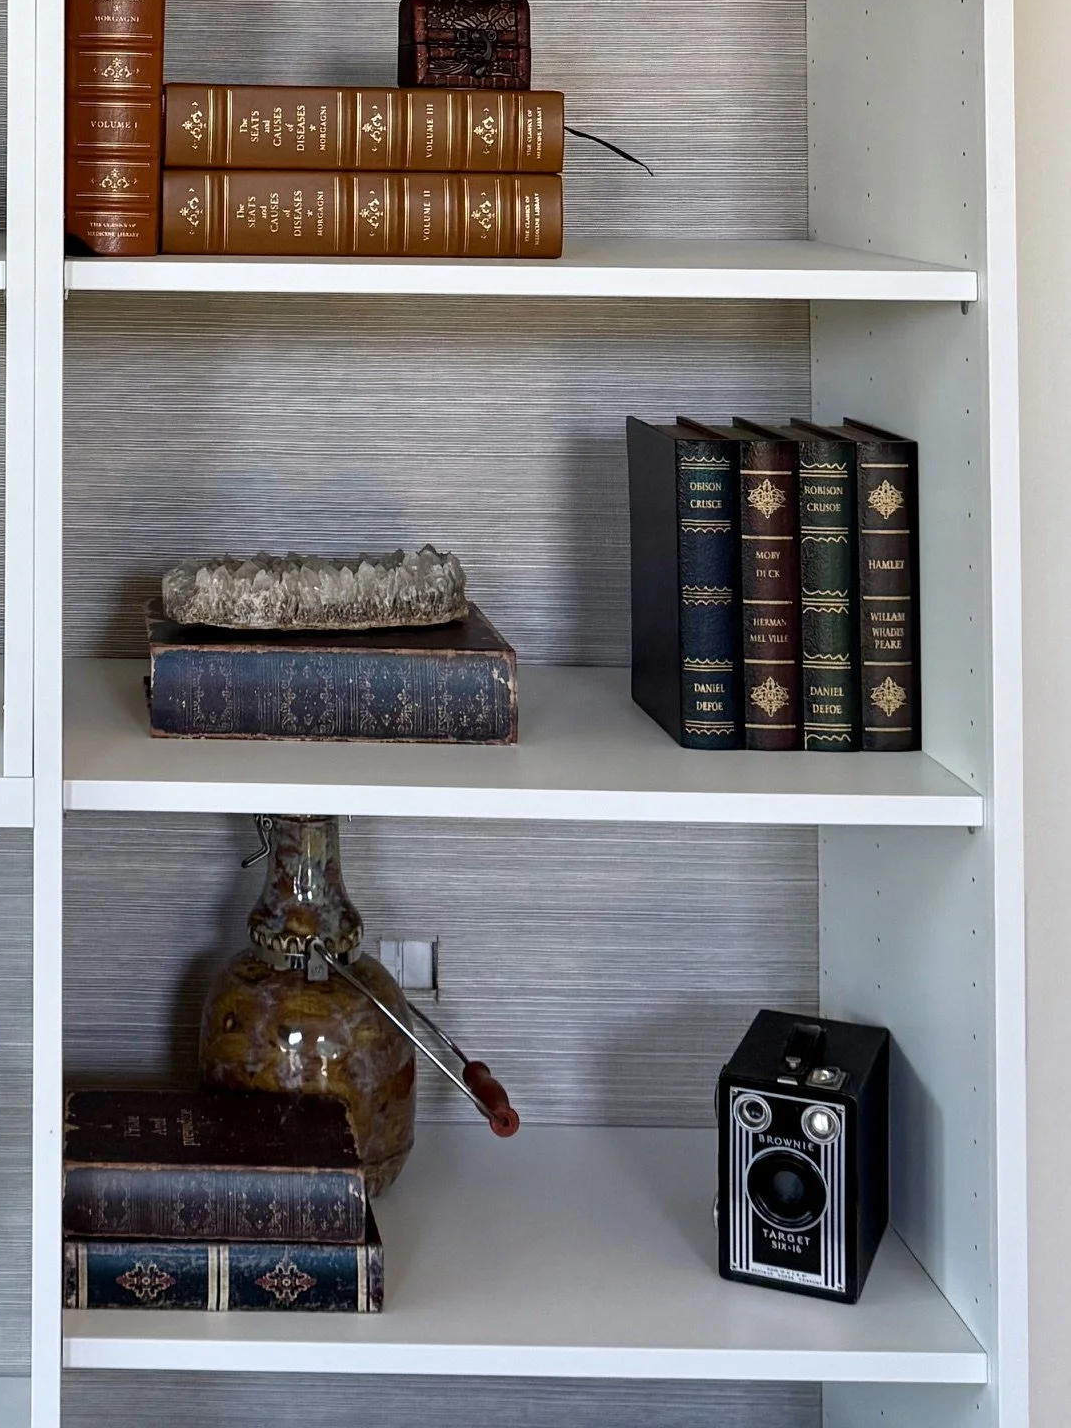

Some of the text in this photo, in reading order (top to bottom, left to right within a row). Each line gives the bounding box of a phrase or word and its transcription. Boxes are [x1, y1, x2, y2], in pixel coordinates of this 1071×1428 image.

[90, 120, 131, 129] VOLUME
[239, 118, 248, 133] The
[250, 110, 260, 143] SEATS
[262, 120, 271, 134] and
[272, 107, 282, 147] CAUSES
[285, 123, 294, 132] of
[296, 105, 306, 151] DISEASES
[319, 105, 327, 151] MORGAGNI
[425, 104, 434, 158] VOLUME III
[236, 203, 245, 219] The
[247, 196, 256, 228] SEATS
[259, 205, 267, 219] and
[270, 192, 279, 233] CAUSES
[282, 209, 291, 218] of
[293, 190, 303, 237] DISEASES
[316, 190, 324, 237] MORGAGNI
[423, 201, 431, 241] VOLUME
[804, 485, 843, 495] ROBISON
[806, 502, 842, 512] CRUSOE
[755, 551, 781, 560] MOBY
[868, 559, 905, 570] HAMLET
[753, 617, 787, 626] HERMAN
[694, 683, 725, 693] DANIEL
[810, 686, 844, 697] DANIEL
[696, 701, 724, 711] DEFOE
[812, 704, 843, 714] DEFOE
[758, 1133, 815, 1152] BROWNIE
[762, 1228, 811, 1246] TARGET
